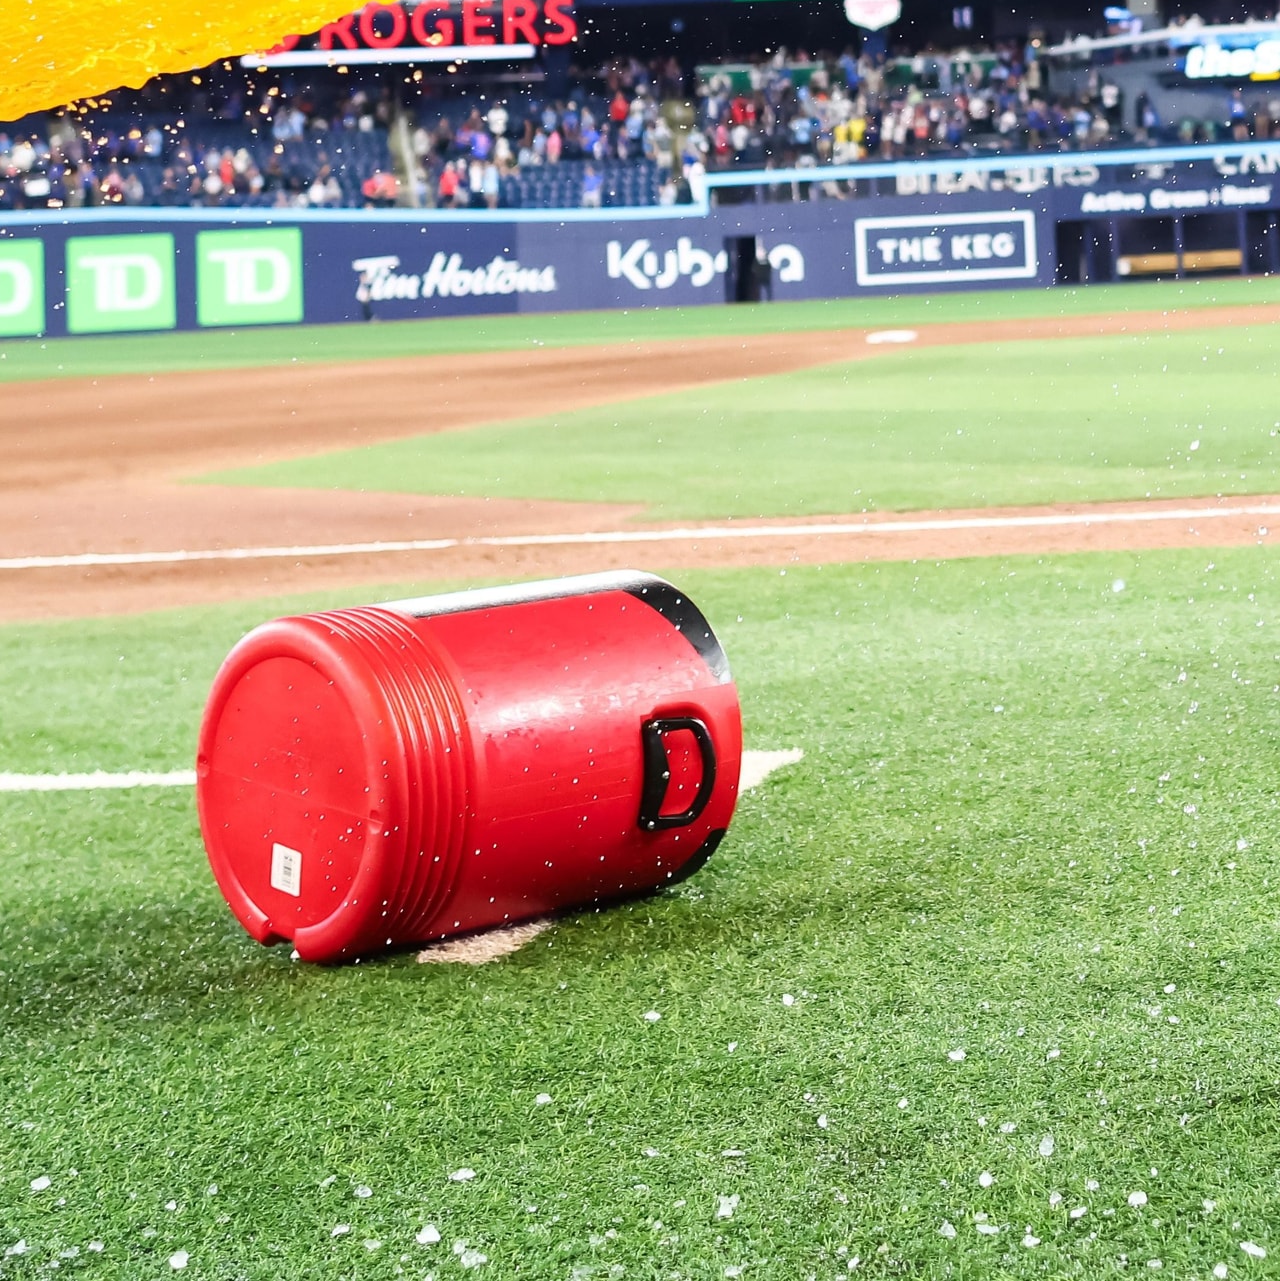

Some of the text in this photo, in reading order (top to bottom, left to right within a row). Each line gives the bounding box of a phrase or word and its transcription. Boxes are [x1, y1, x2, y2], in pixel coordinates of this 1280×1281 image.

[606, 235, 806, 290] Kuba
[876, 231, 1017, 264] THE KEG
[76, 252, 163, 313] TD
[206, 247, 292, 305] TD
[351, 250, 557, 303] Tim Hortons
